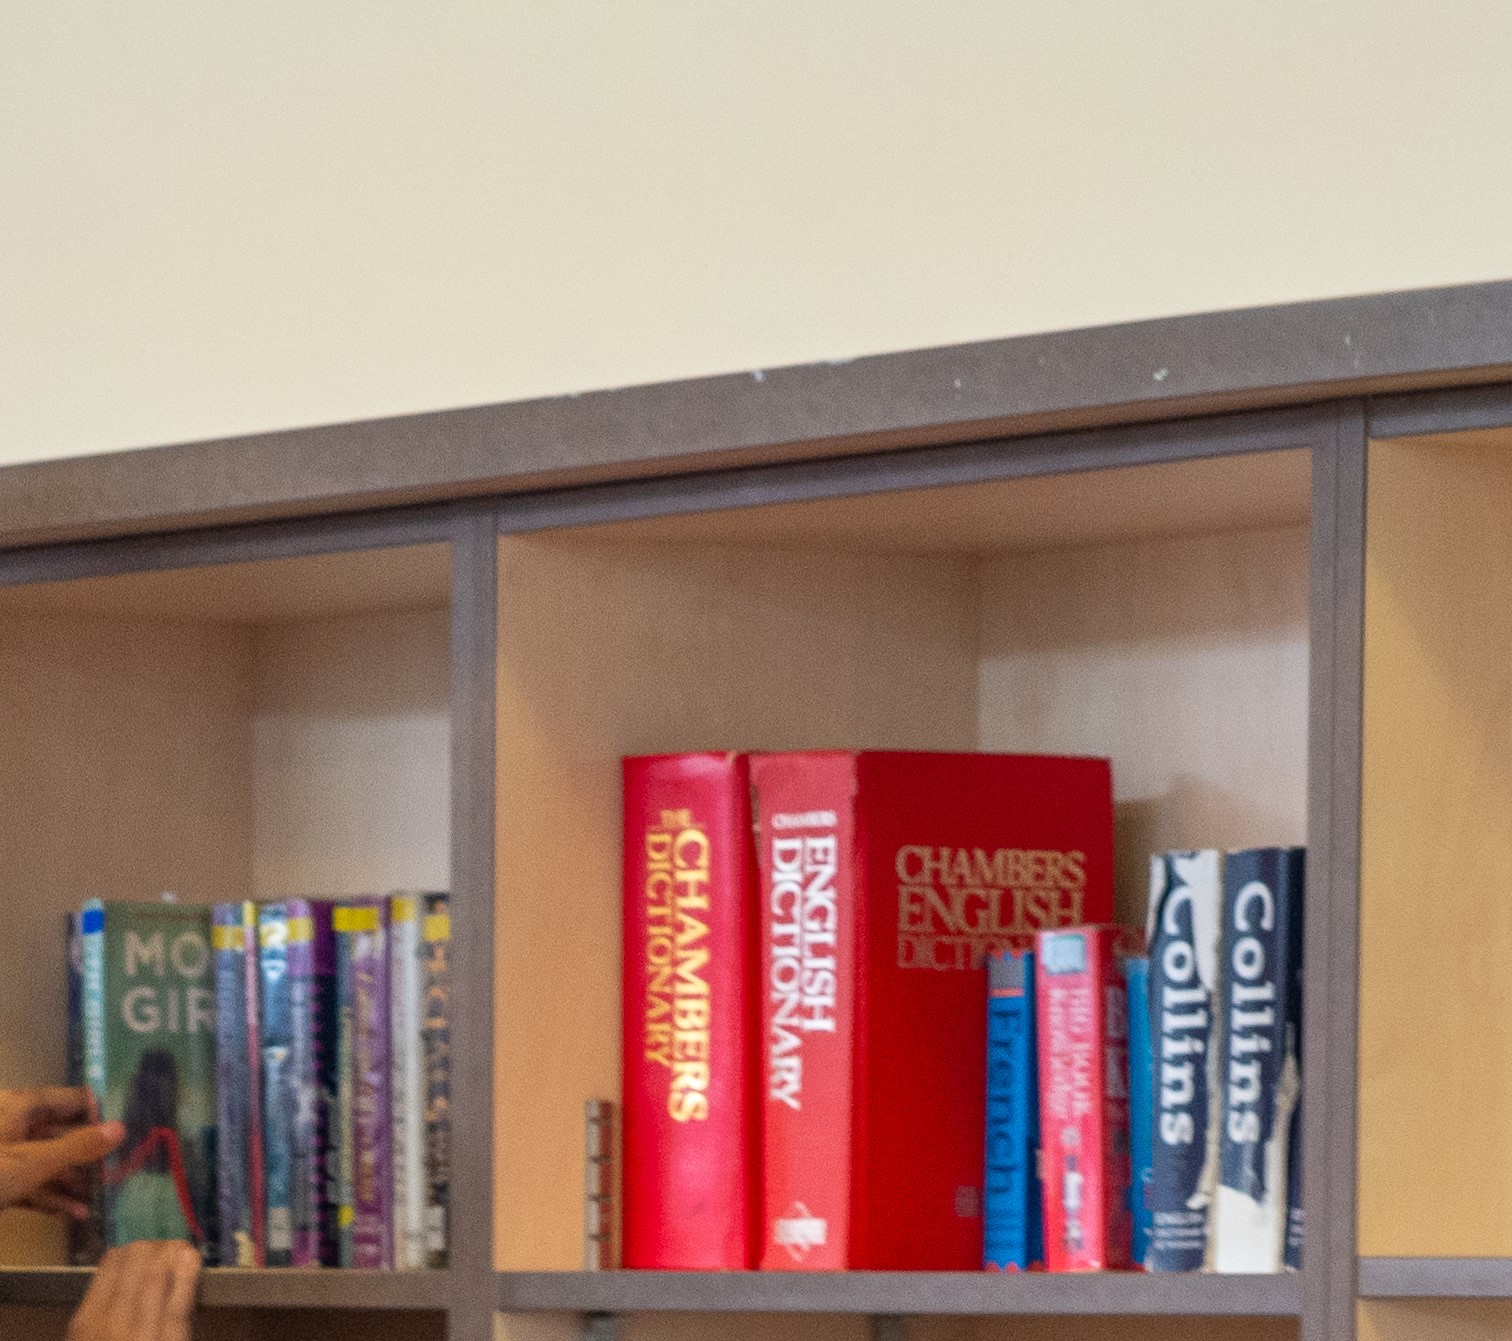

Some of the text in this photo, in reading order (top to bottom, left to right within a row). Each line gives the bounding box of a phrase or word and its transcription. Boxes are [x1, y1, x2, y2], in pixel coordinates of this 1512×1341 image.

[123, 930, 211, 977] MO
[645, 834, 675, 1067] DICTIONARY
[667, 830, 710, 1123] CHAMBERS
[770, 837, 805, 1111] DICTIONARY
[802, 836, 839, 1035] ENGLISH
[895, 845, 1086, 888] CHAMBERS
[898, 884, 1084, 935] ENGLISH
[1160, 886, 1207, 1145] Collins
[1227, 881, 1275, 1145] Collins
